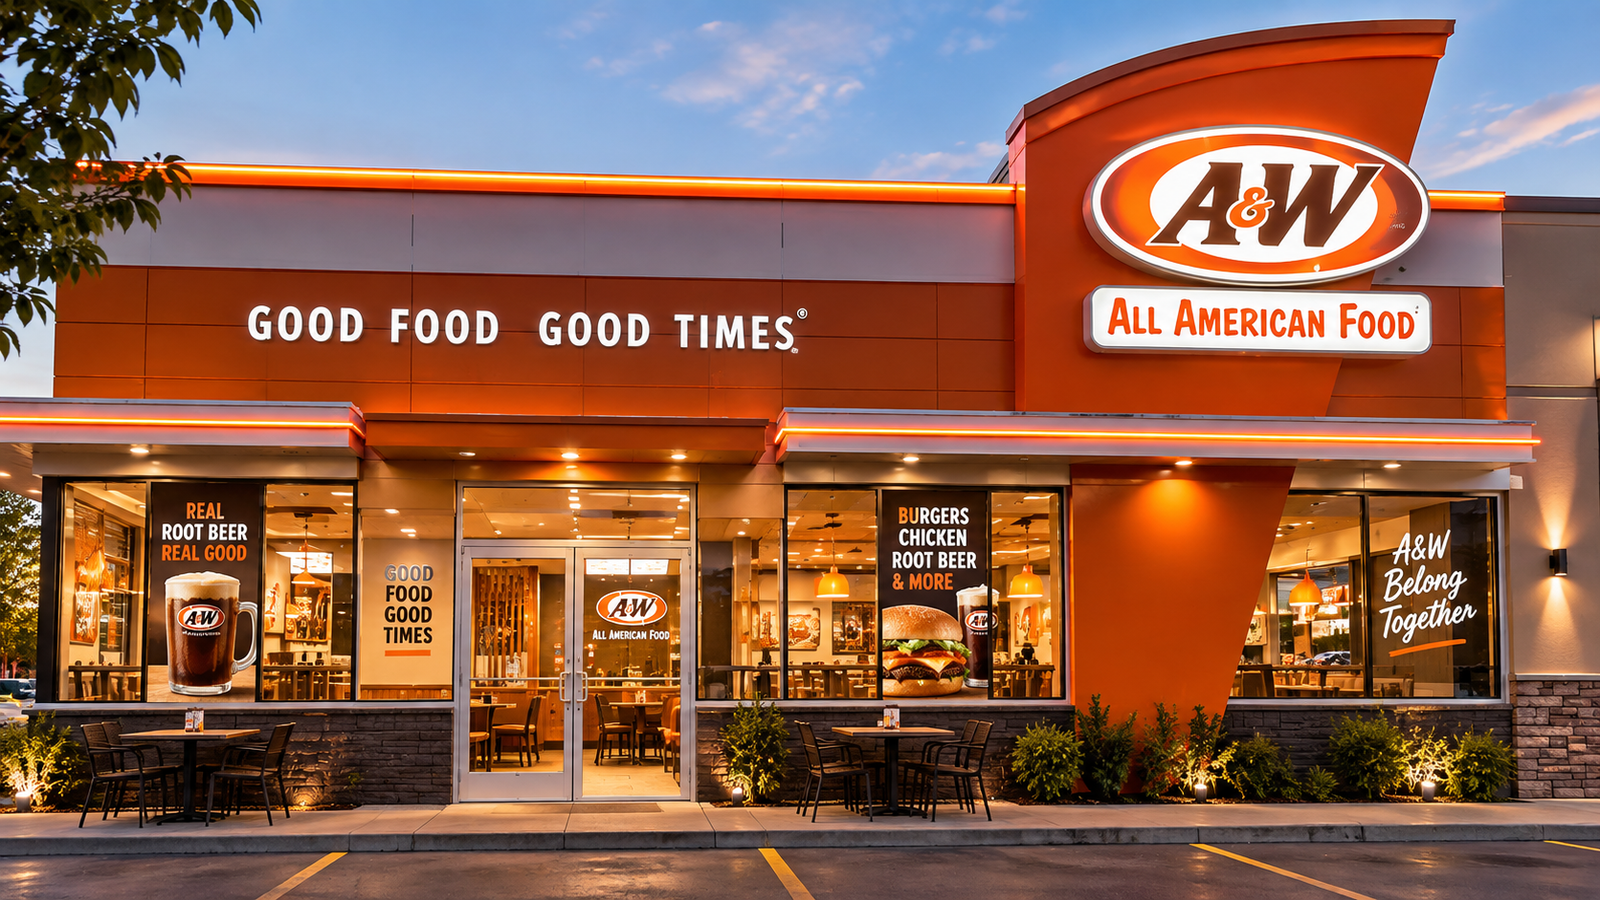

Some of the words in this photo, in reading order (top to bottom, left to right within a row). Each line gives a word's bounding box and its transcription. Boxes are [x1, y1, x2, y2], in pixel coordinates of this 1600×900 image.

[1150, 161, 1383, 248] A&W
[1107, 297, 1162, 336] ALL
[1174, 298, 1325, 338] AMERICAN
[1339, 302, 1416, 340] FOOD
[247, 305, 364, 343] GOOD
[390, 307, 500, 346] FOOD
[538, 311, 651, 348] GOOD
[674, 313, 795, 351] TIMES
[186, 502, 224, 520] REAL
[898, 506, 970, 525] BURGERS
[161, 523, 204, 541] ROOT
[208, 523, 248, 541] BEER
[899, 528, 967, 547] CHICKEN
[161, 544, 200, 561] REAL
[204, 544, 247, 562] GOOD
[1392, 529, 1451, 566] A&W
[892, 551, 934, 569] ROOT
[938, 551, 977, 569] BEER
[384, 564, 434, 582] GOOD
[892, 573, 904, 590] &
[909, 573, 954, 590] MORE
[1383, 564, 1468, 602] Belong
[385, 585, 433, 602] FOOD
[384, 606, 433, 623] GOOD
[608, 598, 657, 618] A&W
[1379, 597, 1477, 644] Together
[383, 626, 433, 644] TIMES
[592, 629, 607, 640] ALL
[609, 629, 647, 640] AMERICAN
[649, 629, 670, 640] FOOD
